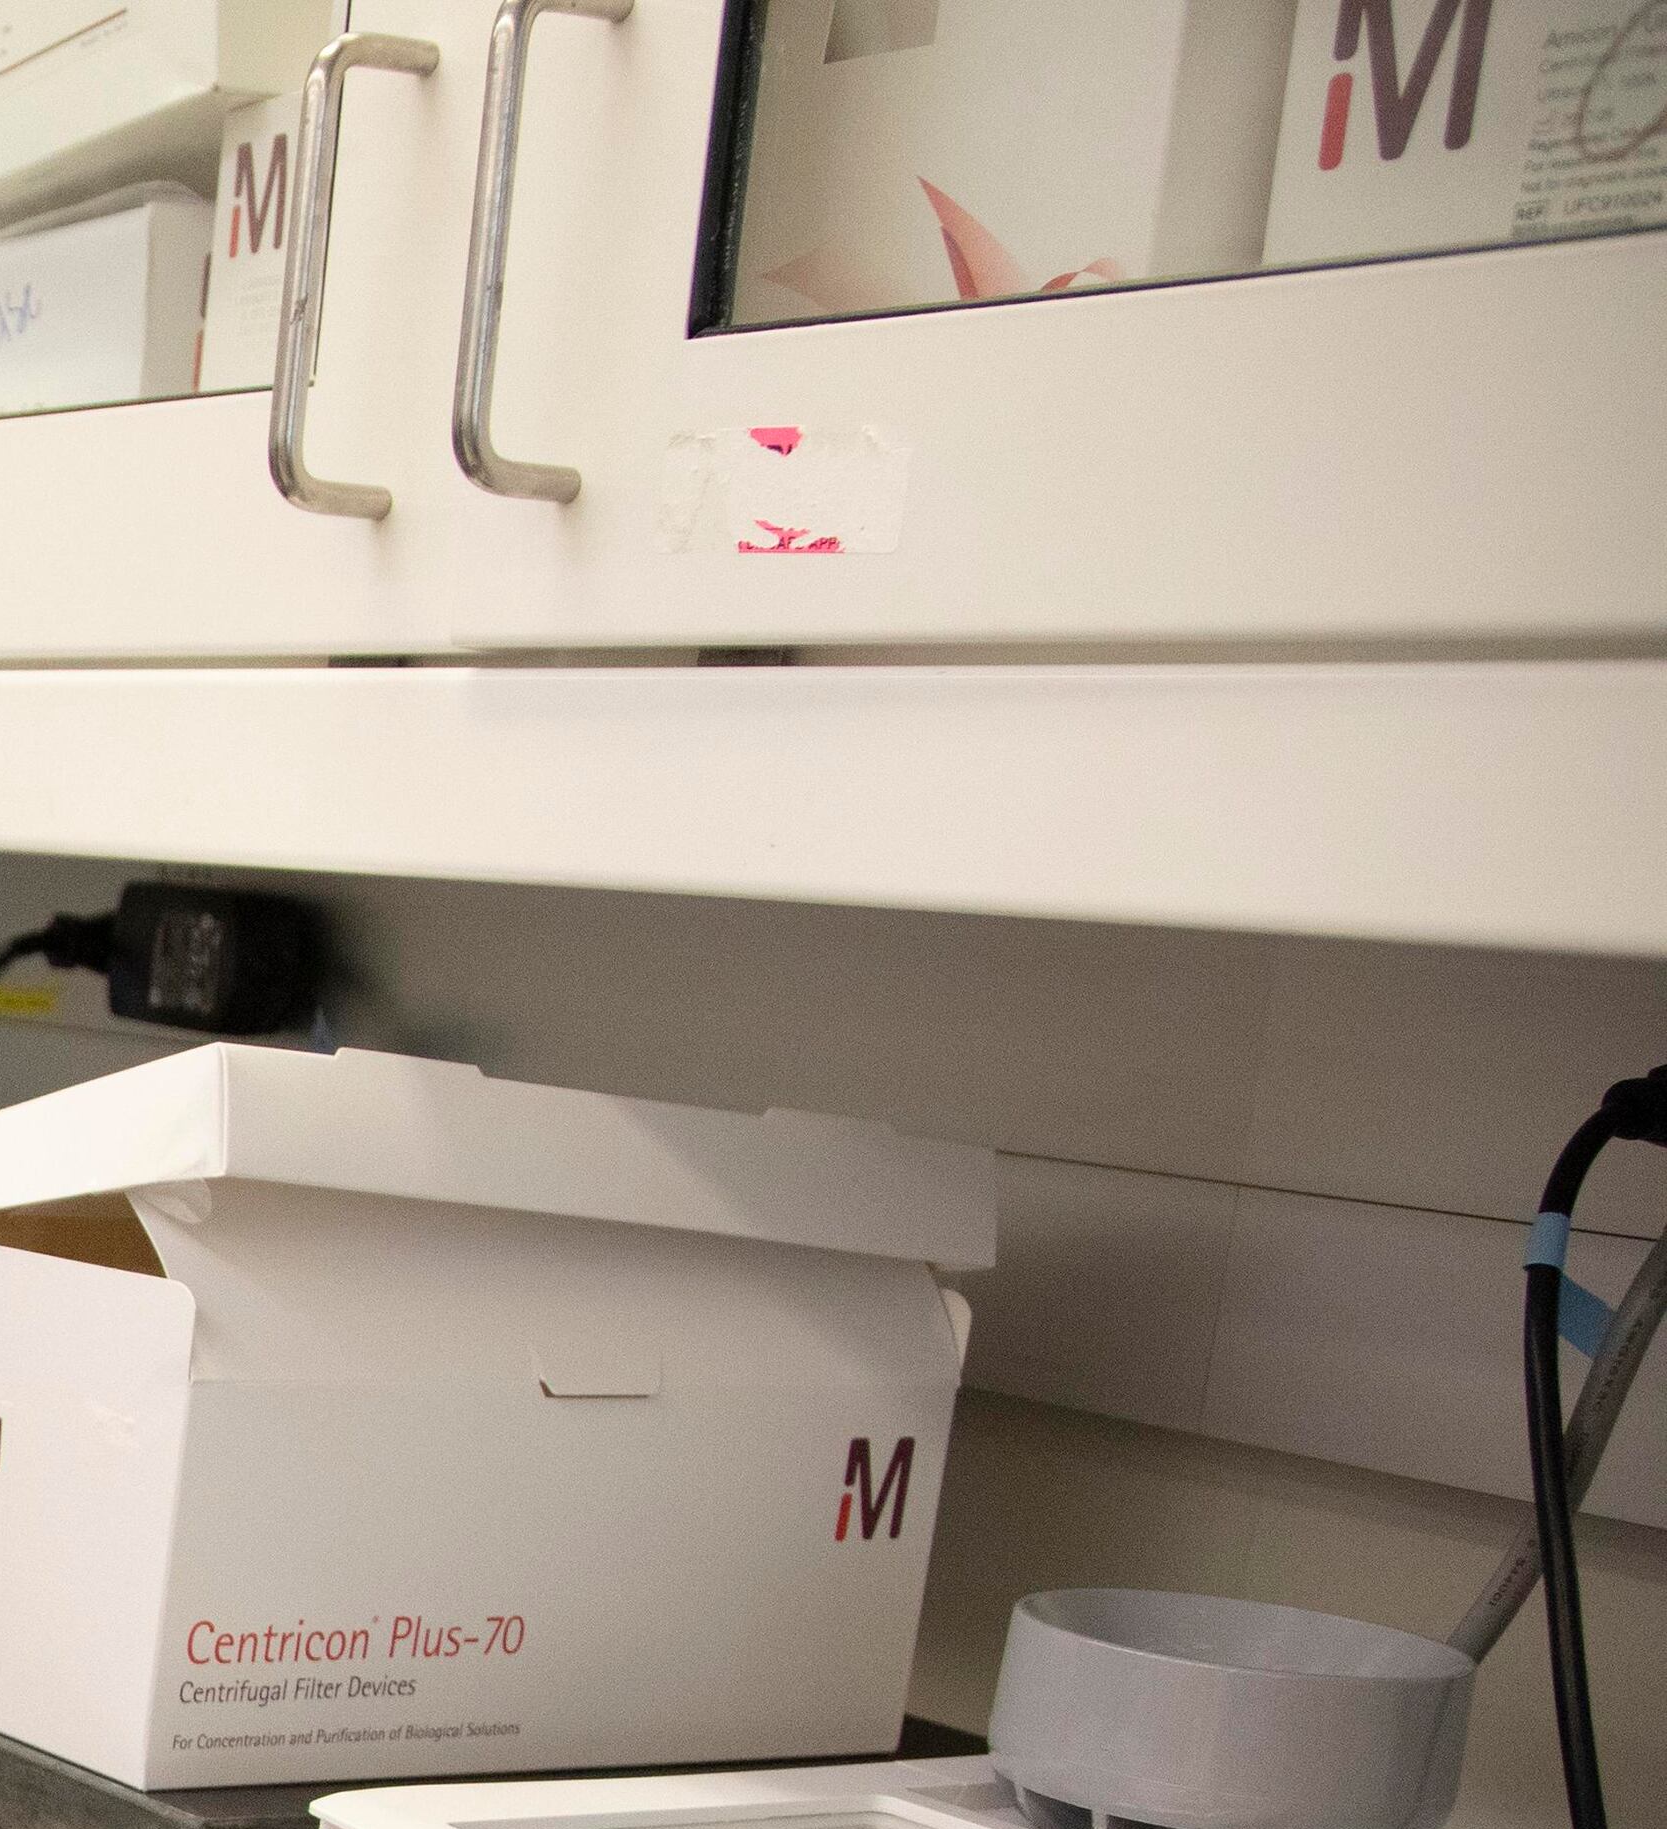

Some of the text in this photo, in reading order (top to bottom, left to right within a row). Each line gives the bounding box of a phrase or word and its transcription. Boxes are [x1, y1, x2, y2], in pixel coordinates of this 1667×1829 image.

[388, 1614, 527, 1659] Plus-70
[179, 1675, 417, 1708] Centrifugal Filter Devices
[172, 1721, 521, 1751] For Concentration and Purification of Biological Solutions
